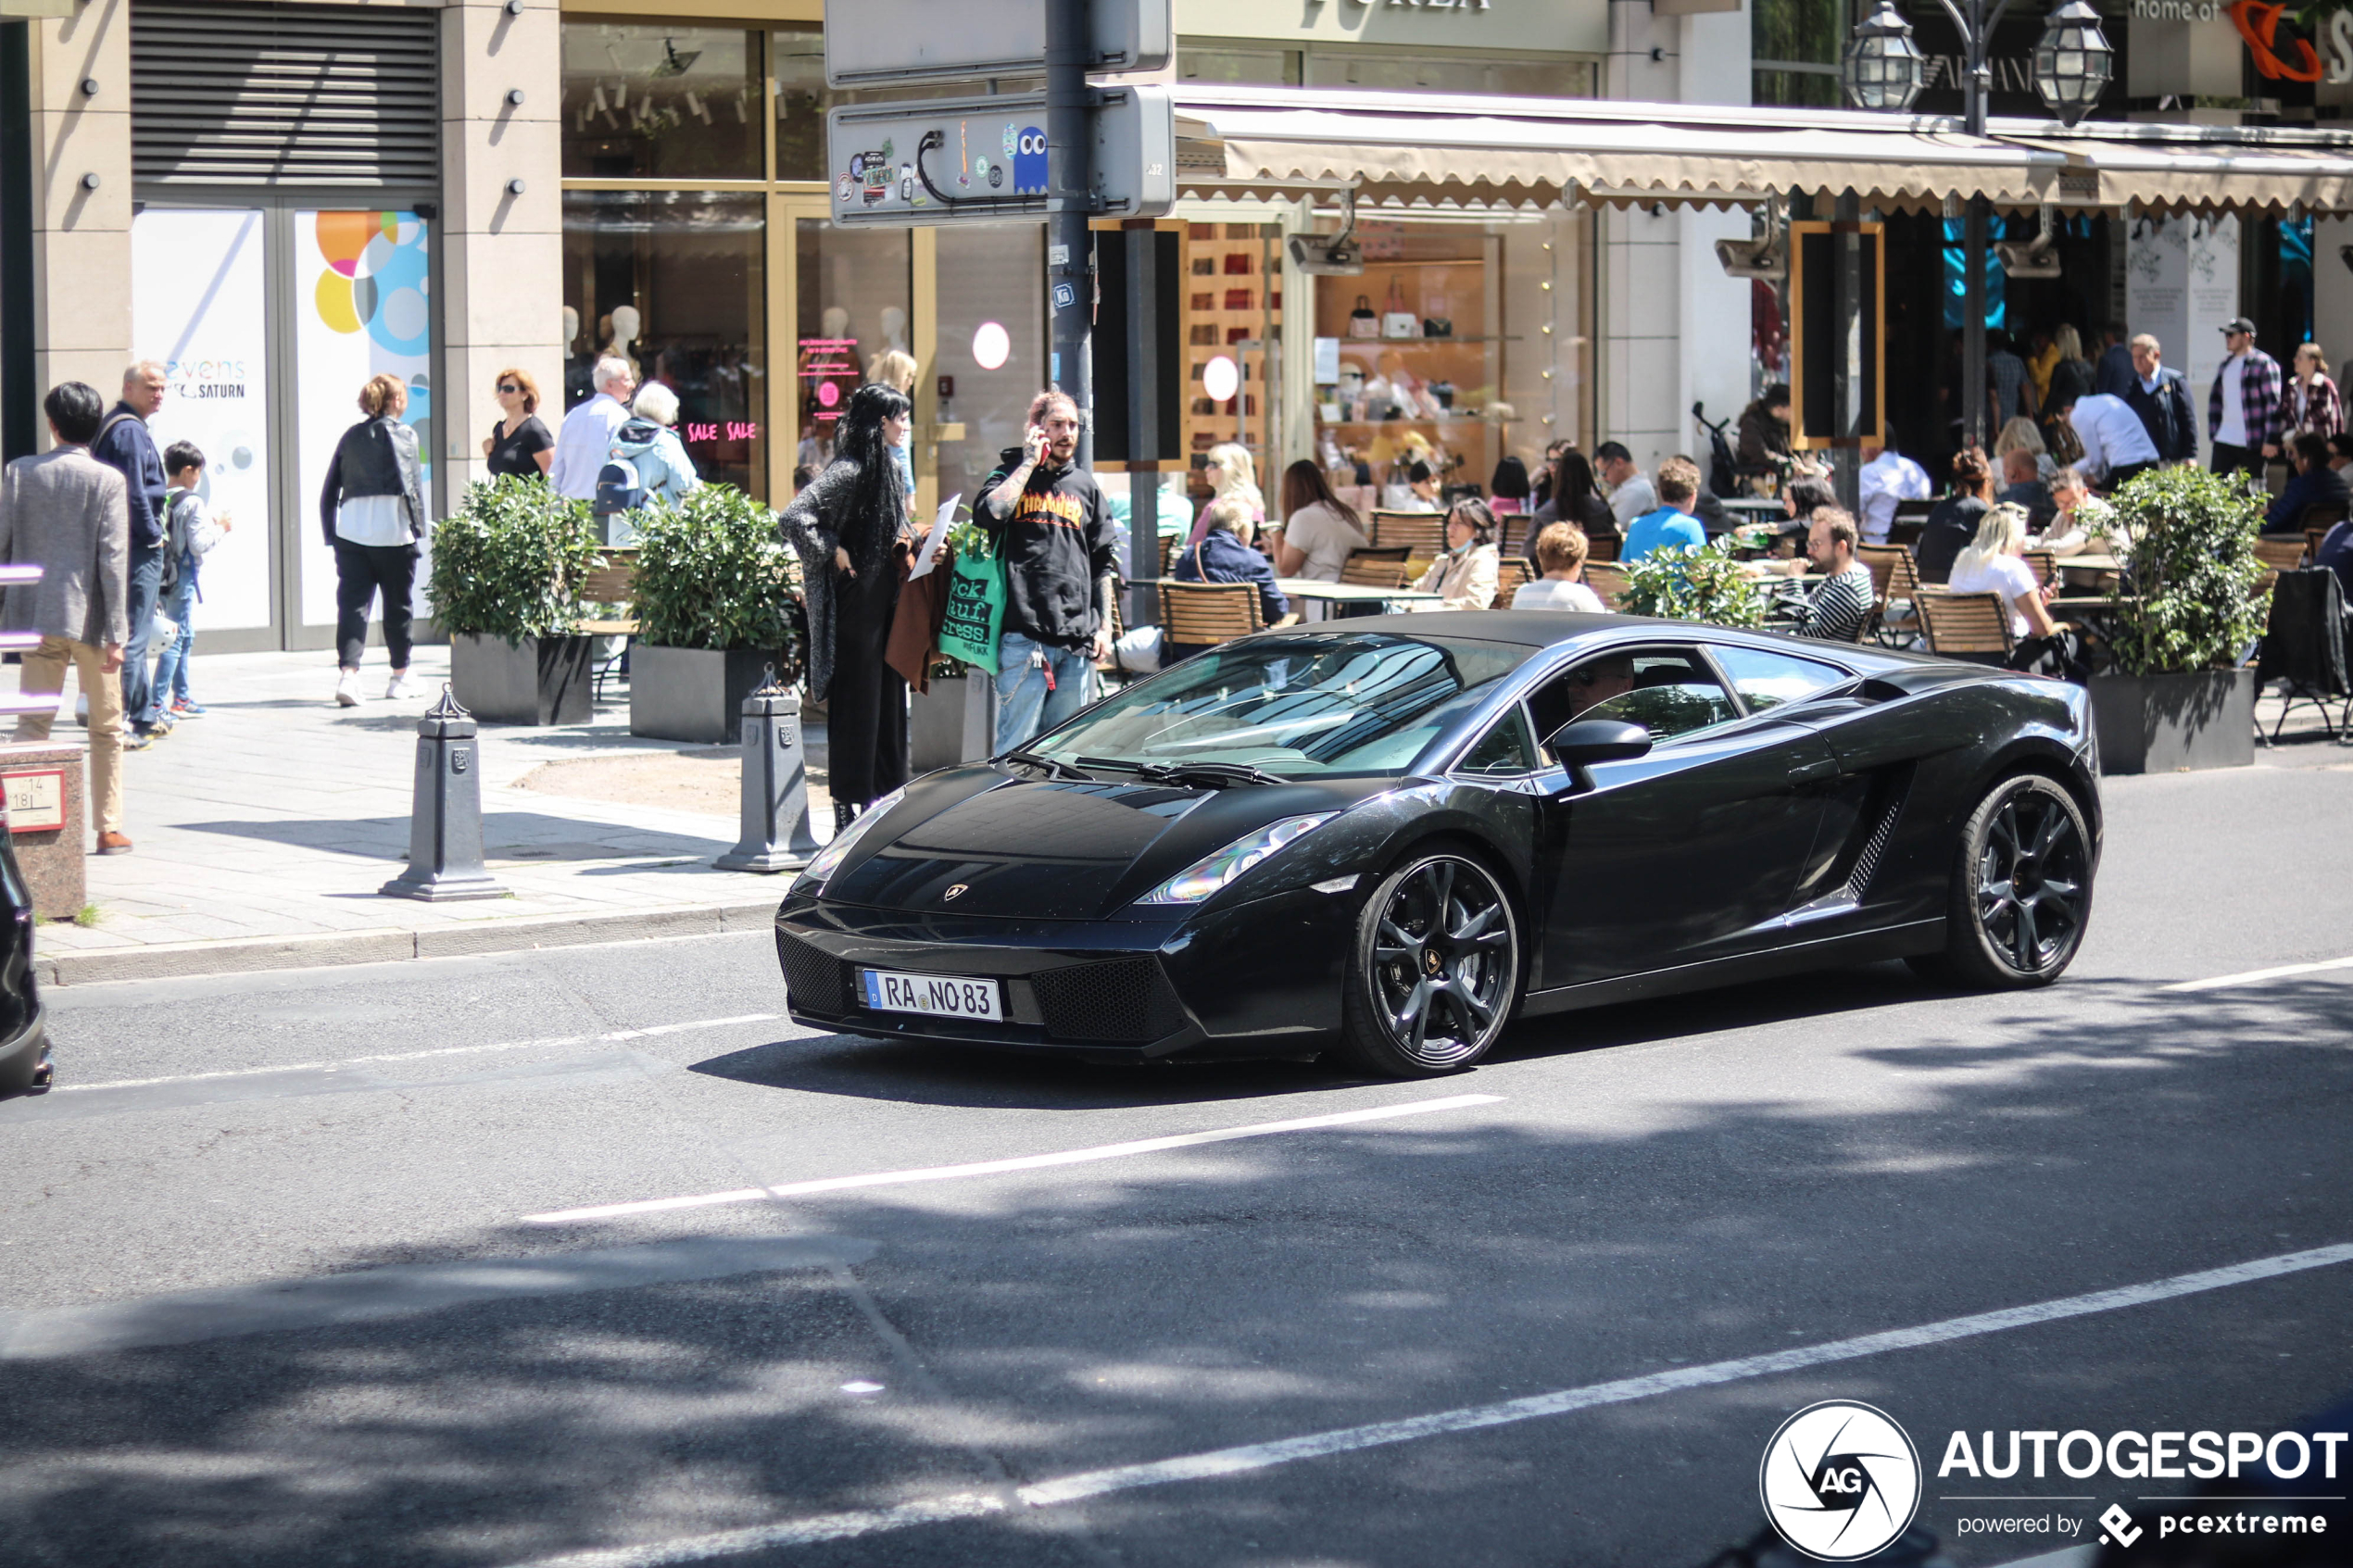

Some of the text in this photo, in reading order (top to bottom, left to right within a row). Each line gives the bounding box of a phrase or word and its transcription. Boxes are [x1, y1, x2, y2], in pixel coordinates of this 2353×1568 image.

[2134, 0, 2191, 20] home
[2198, 1, 2221, 21] of
[198, 384, 245, 398] SATURN
[687, 421, 756, 443] SALE SALE
[13, 794, 28, 807] 18
[885, 977, 917, 1008] RA
